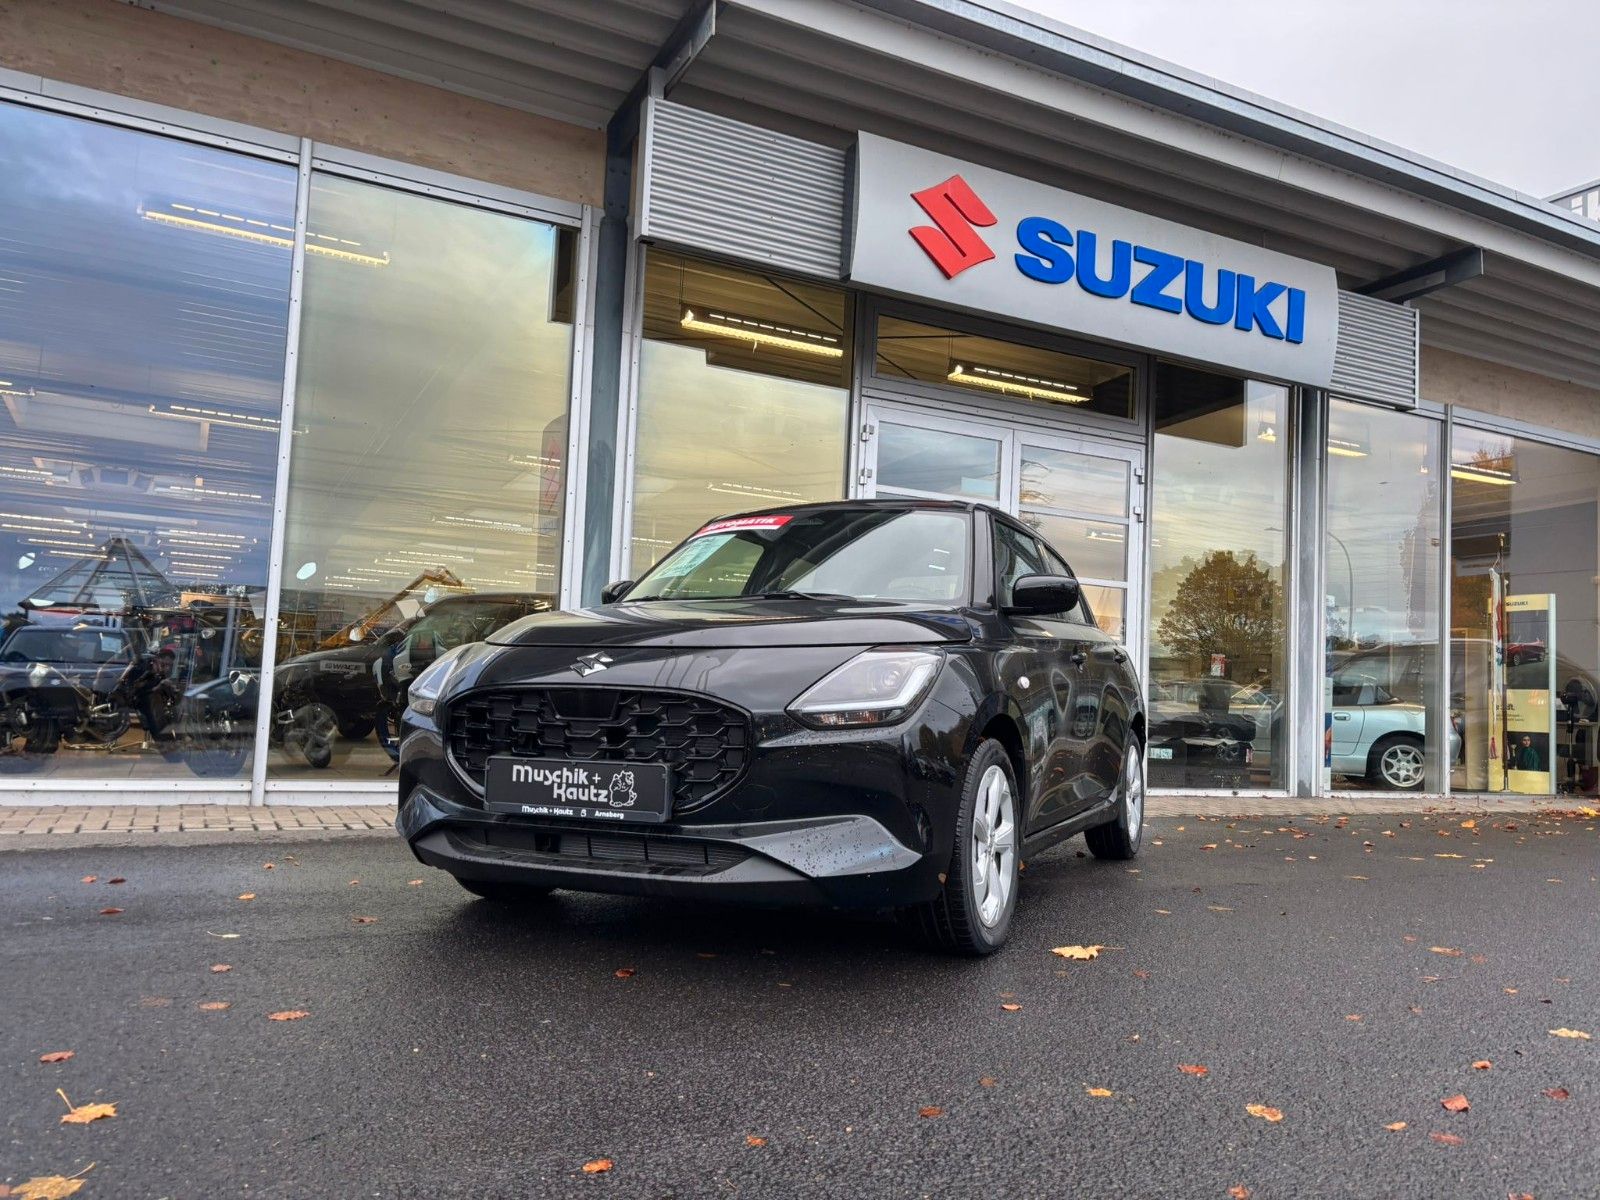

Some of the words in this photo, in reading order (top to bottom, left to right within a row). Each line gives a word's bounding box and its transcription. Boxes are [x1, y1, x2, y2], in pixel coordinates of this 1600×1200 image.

[1014, 216, 1306, 344] SUZUKI
[512, 764, 589, 786] Muschik
[553, 783, 608, 802] Kautz
[553, 807, 574, 816] Kautz
[594, 810, 624, 820] Arnsberg
